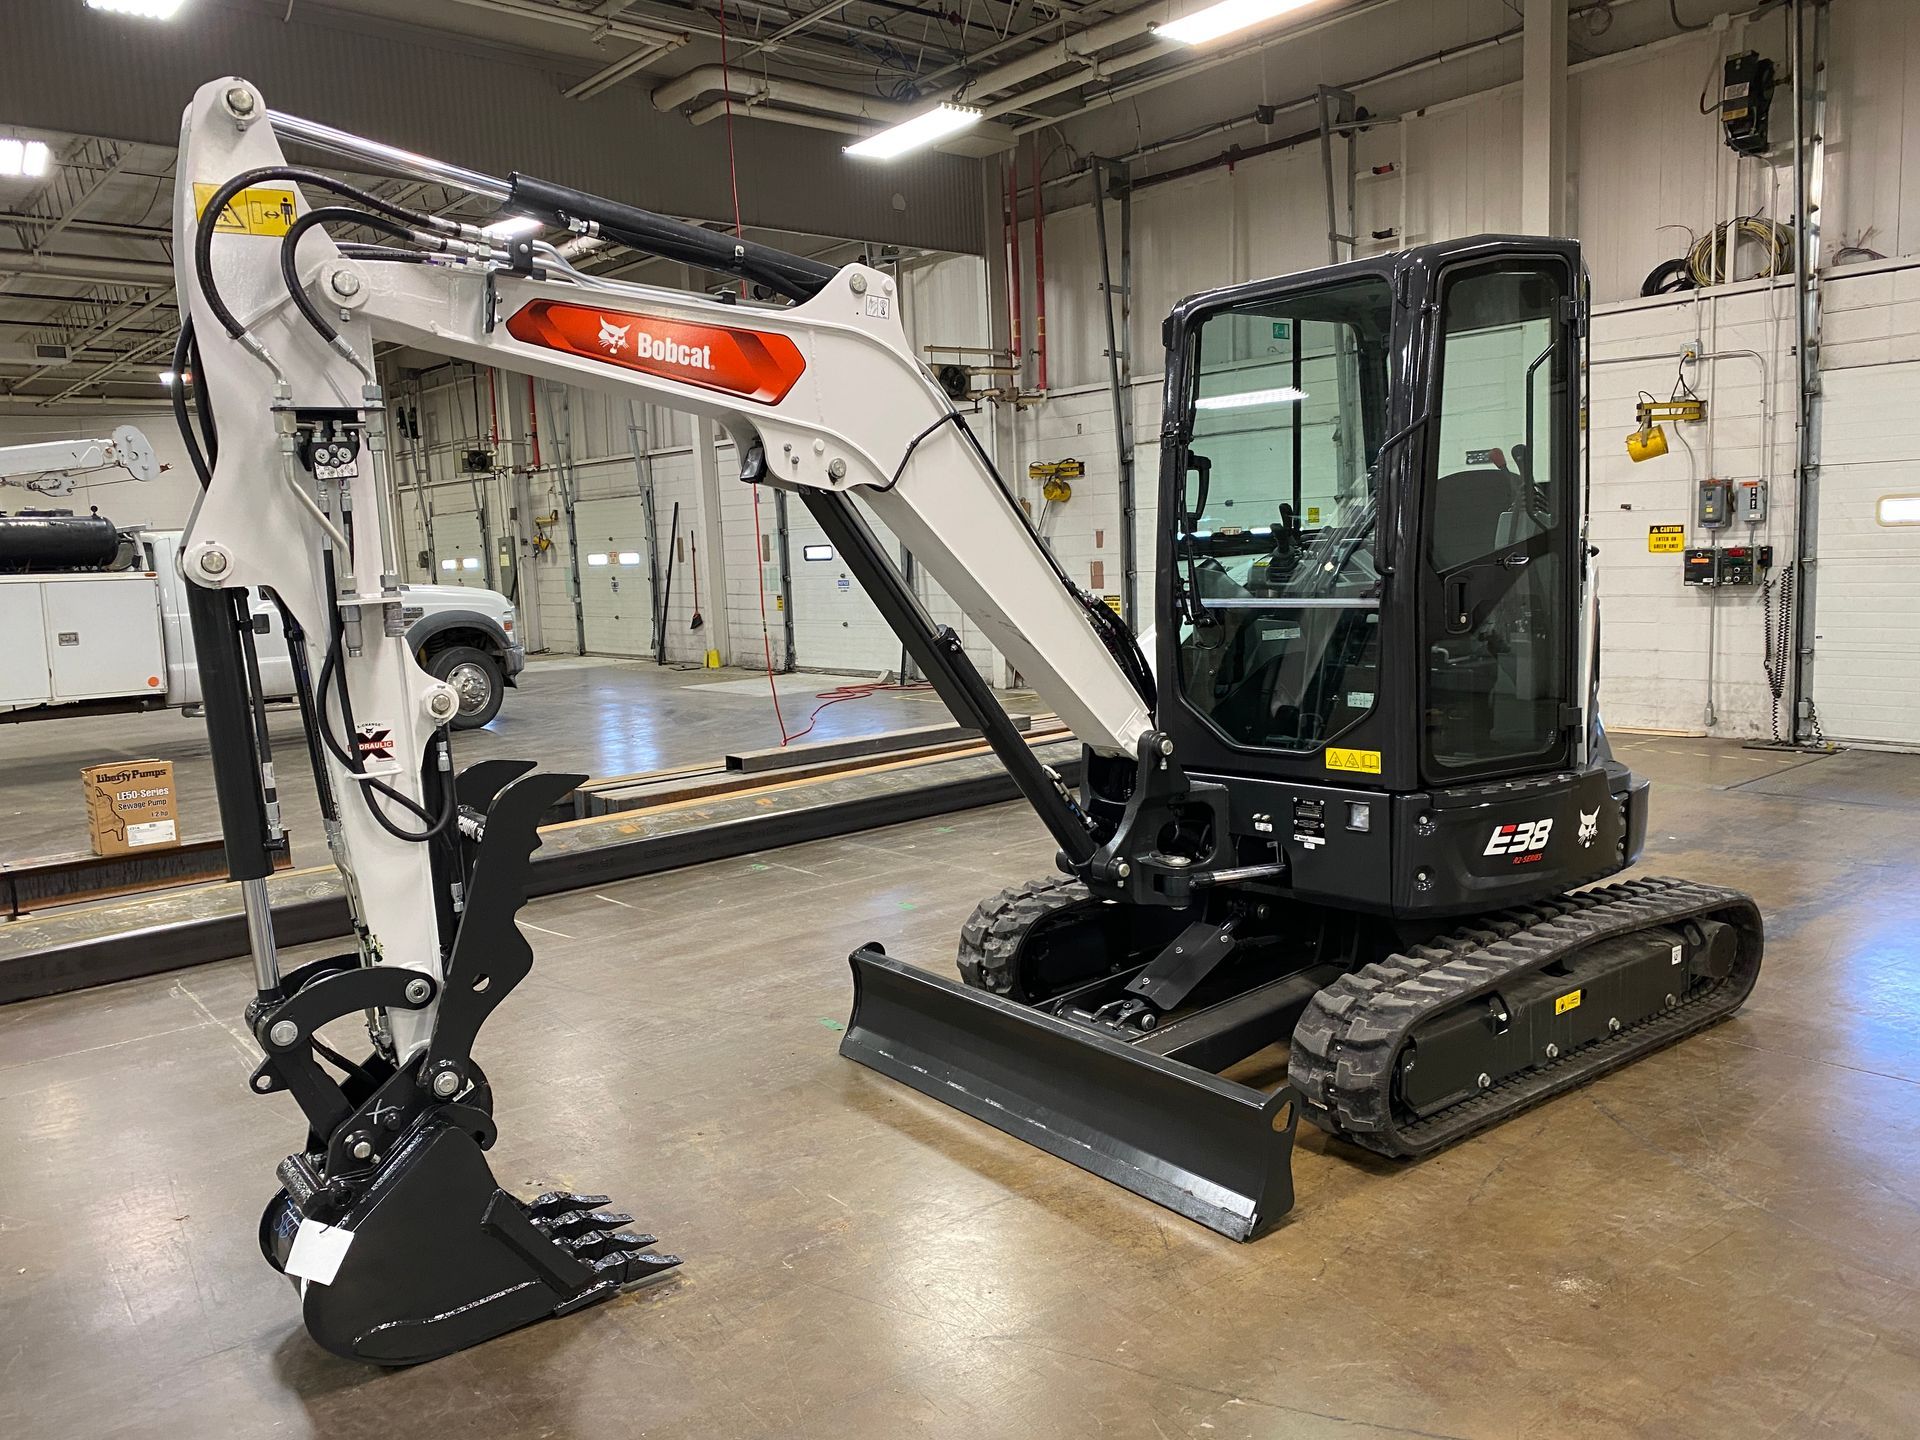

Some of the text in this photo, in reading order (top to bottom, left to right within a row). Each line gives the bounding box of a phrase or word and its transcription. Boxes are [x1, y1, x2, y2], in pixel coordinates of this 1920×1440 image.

[637, 332, 711, 370] Bobcat
[96, 769, 166, 784] Liberty Pumps
[118, 799, 167, 811] Sewage Pump
[1482, 818, 1553, 856] E38
